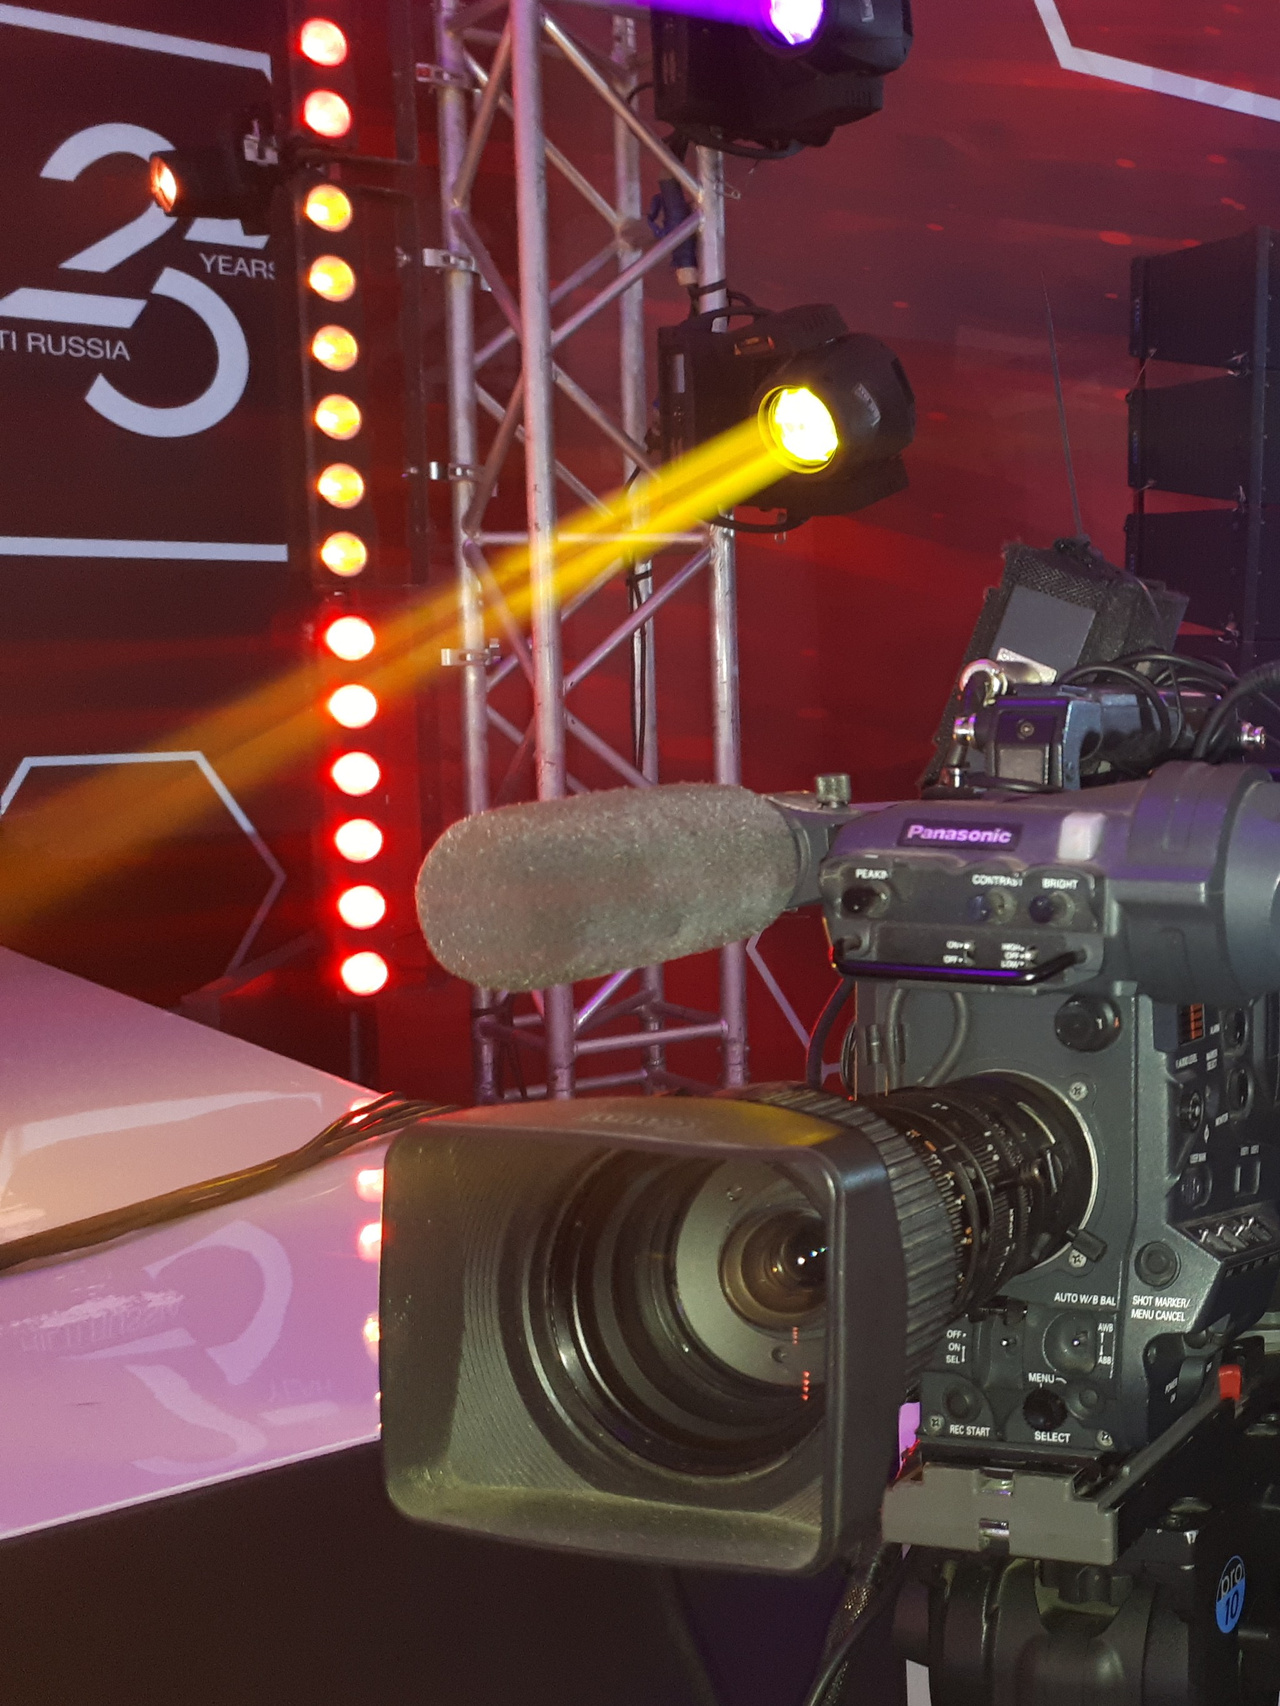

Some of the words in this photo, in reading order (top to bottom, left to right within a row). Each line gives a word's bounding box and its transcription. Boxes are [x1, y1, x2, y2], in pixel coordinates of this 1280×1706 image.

[27, 332, 131, 361] RUSSIA
[907, 824, 1012, 843] Panasonic
[1042, 878, 1079, 890] BRIGHT
[1054, 1292, 1078, 1304] AUTO
[1080, 1294, 1099, 1305] W/B
[1100, 1295, 1117, 1307] BAL
[1132, 1295, 1153, 1306] SHOT
[1154, 1296, 1191, 1308] MARKER/
[1130, 1309, 1154, 1320] MENU
[1155, 1310, 1186, 1322] CANCEL
[946, 1330, 961, 1339] OFF
[1098, 1323, 1114, 1333] AWB
[948, 1343, 961, 1352] ON
[946, 1355, 961, 1364] SEL
[1028, 1372, 1055, 1383] MENU
[950, 1424, 965, 1435] REC
[966, 1426, 991, 1437] START
[1034, 1431, 1071, 1443] SELECT
[1221, 1563, 1243, 1600] pro
[1225, 1590, 1239, 1626] 10
